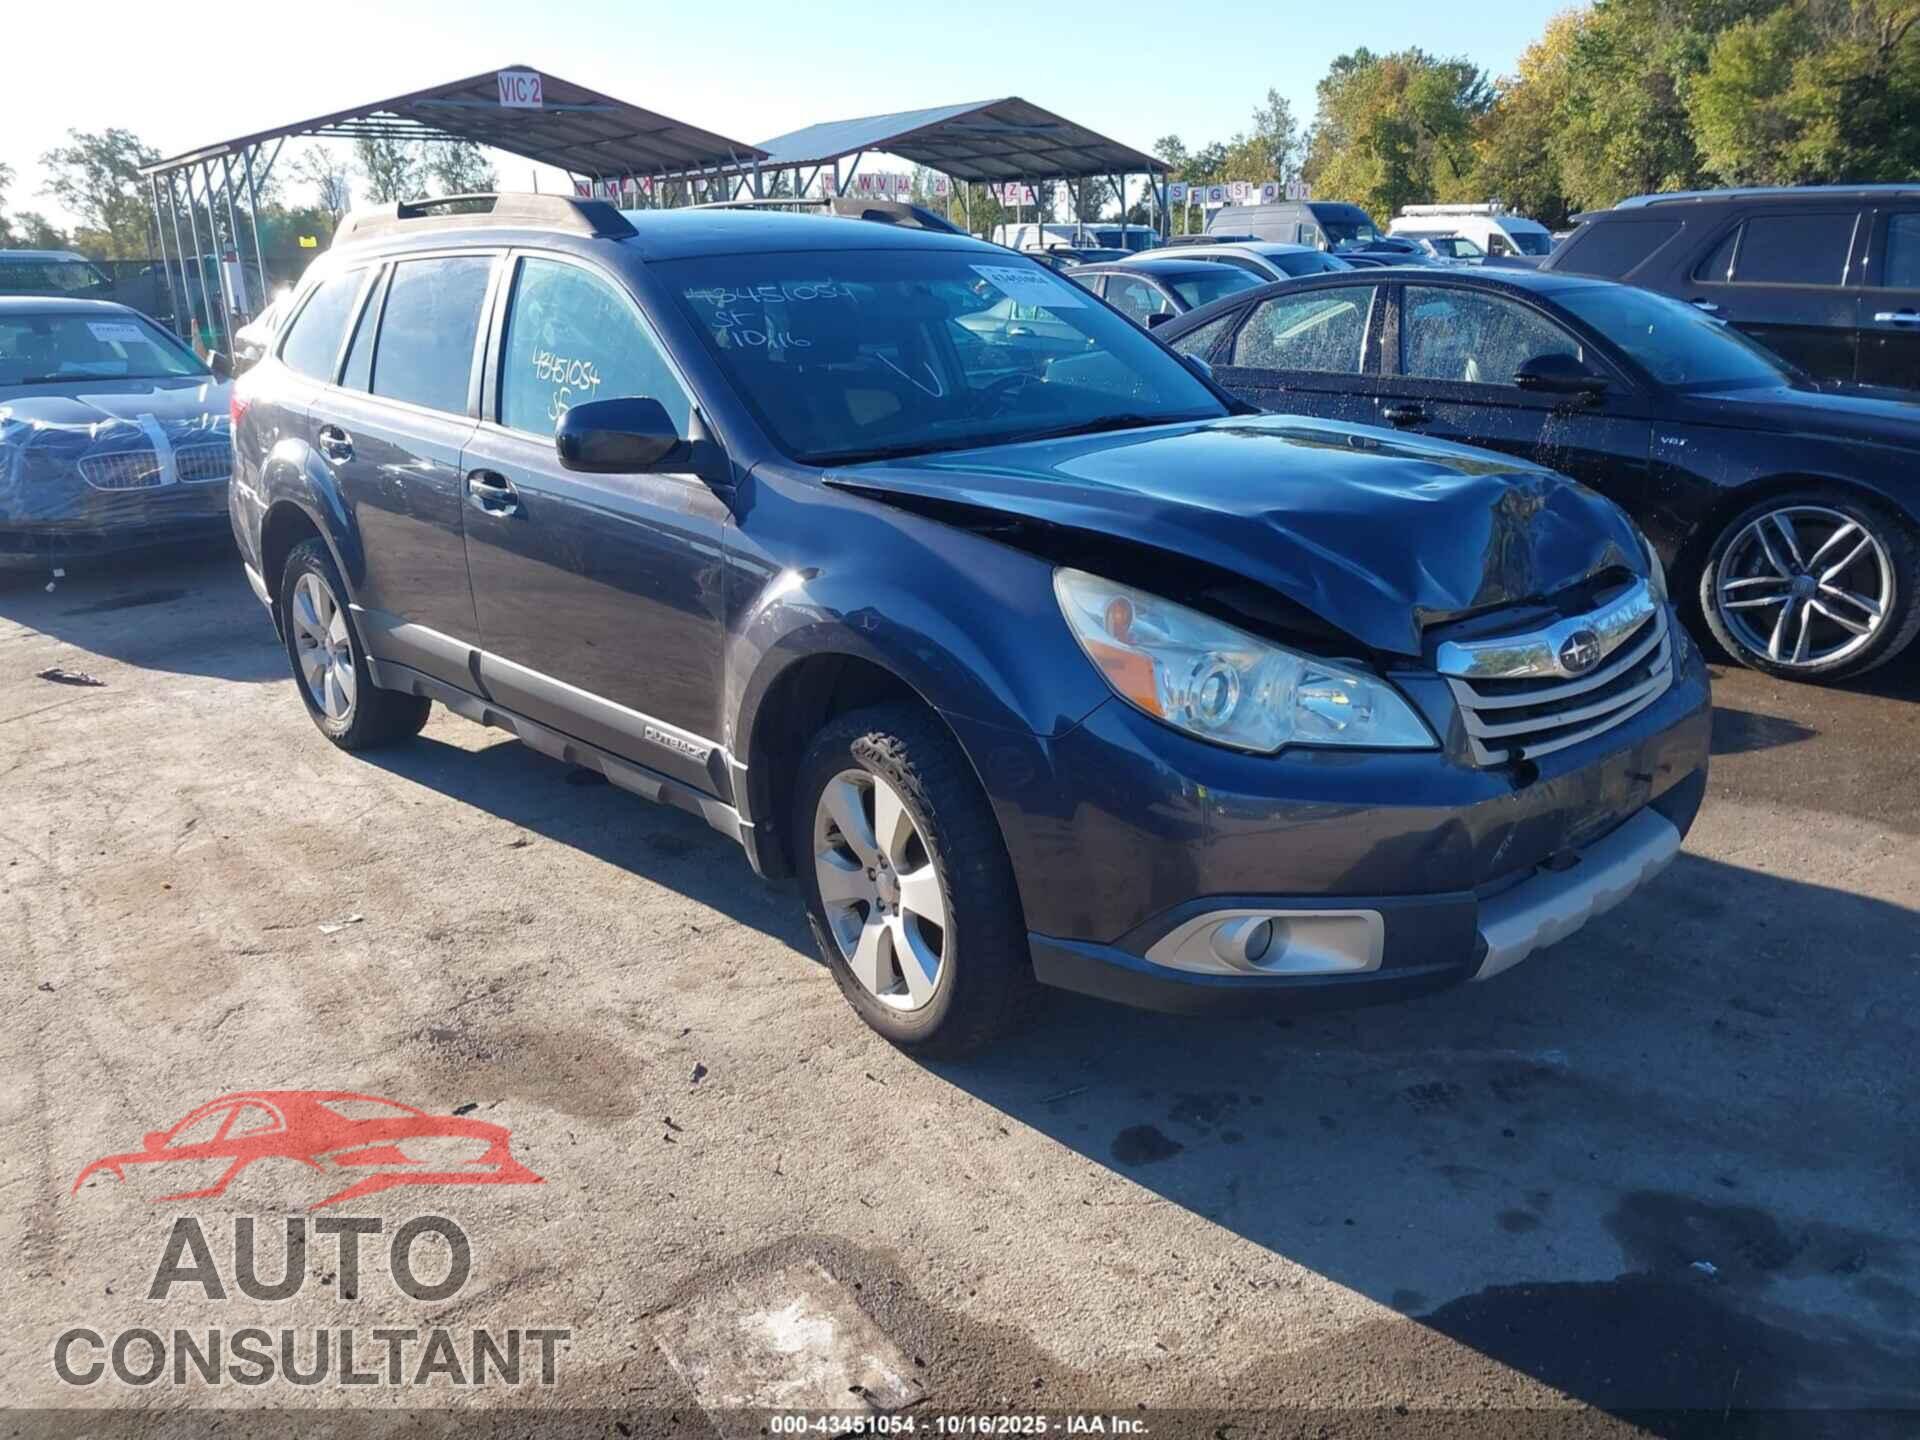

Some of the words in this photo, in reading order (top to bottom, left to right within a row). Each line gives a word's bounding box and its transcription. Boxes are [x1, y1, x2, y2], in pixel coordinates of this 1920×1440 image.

[499, 76, 527, 102] VIC
[530, 78, 541, 103] 2
[1173, 186, 1182, 198] S
[1211, 188, 1221, 201] G
